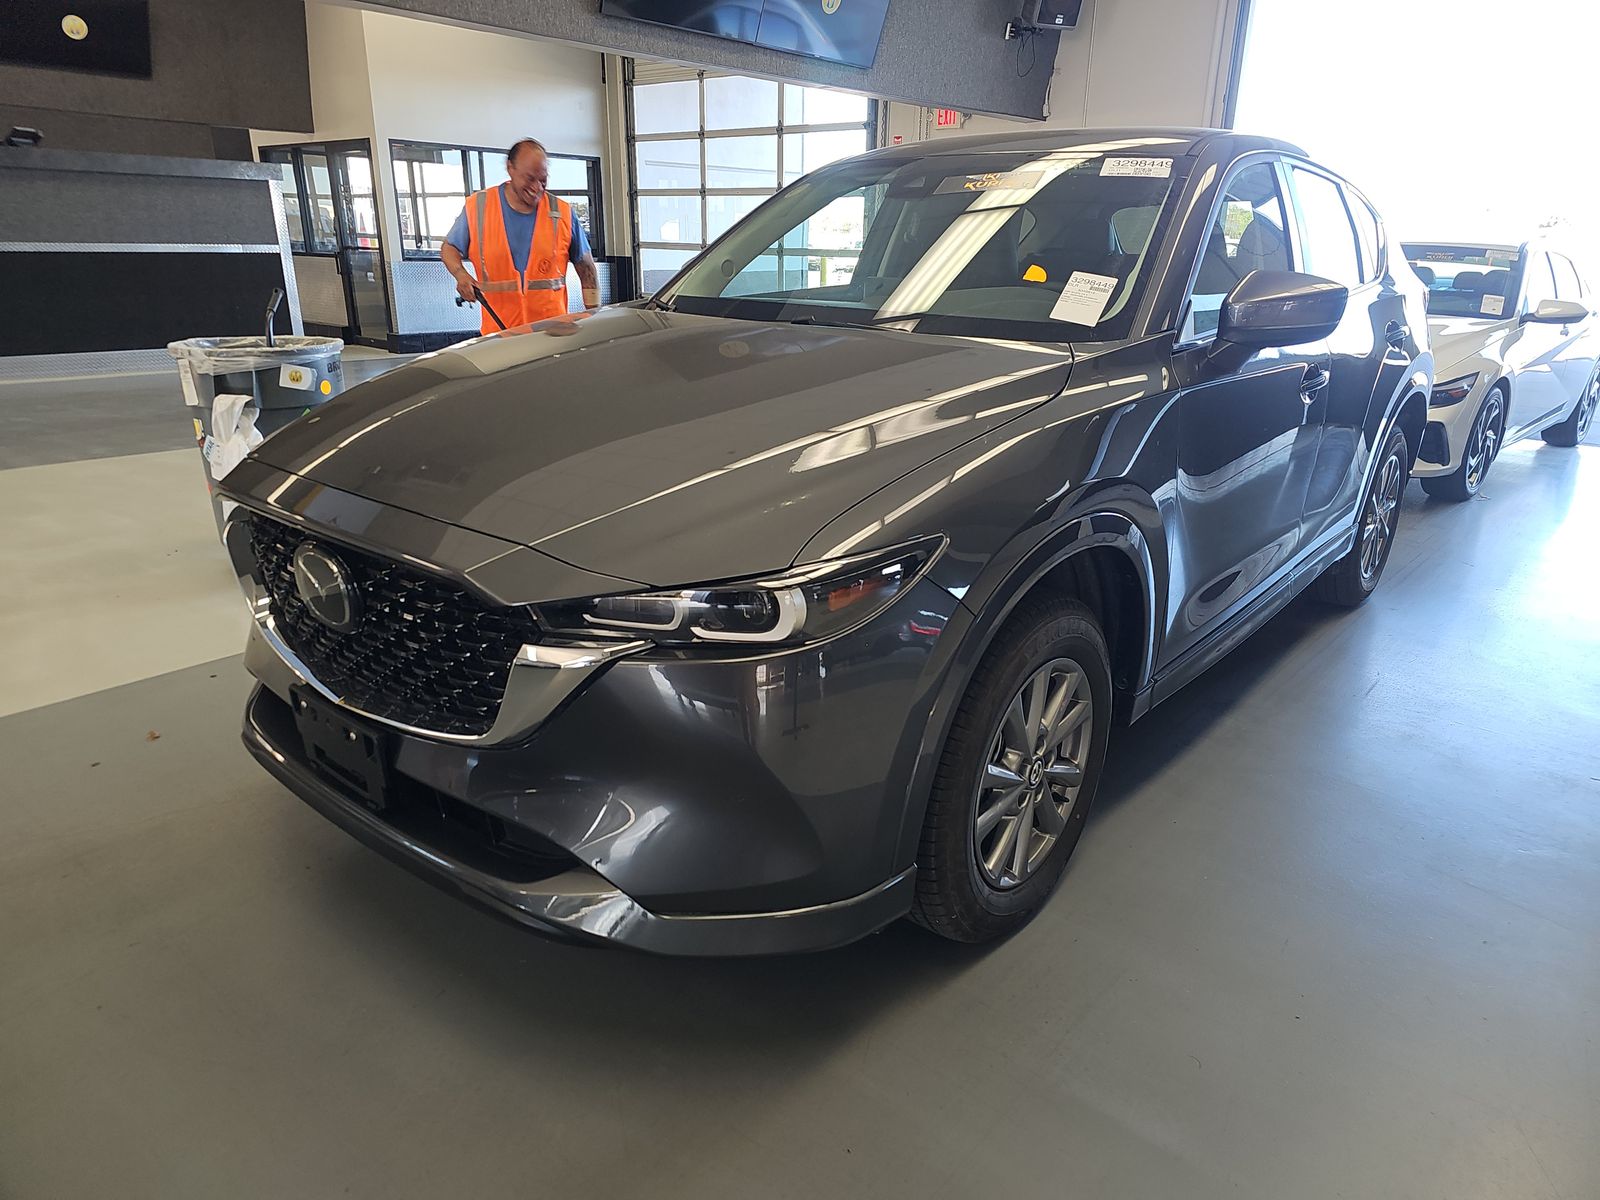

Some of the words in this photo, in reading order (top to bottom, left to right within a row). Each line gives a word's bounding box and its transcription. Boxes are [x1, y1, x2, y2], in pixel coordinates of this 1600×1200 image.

[937, 109, 957, 126] EXIT
[1112, 159, 1172, 168] 3298449
[1071, 276, 1115, 290] 3298449
